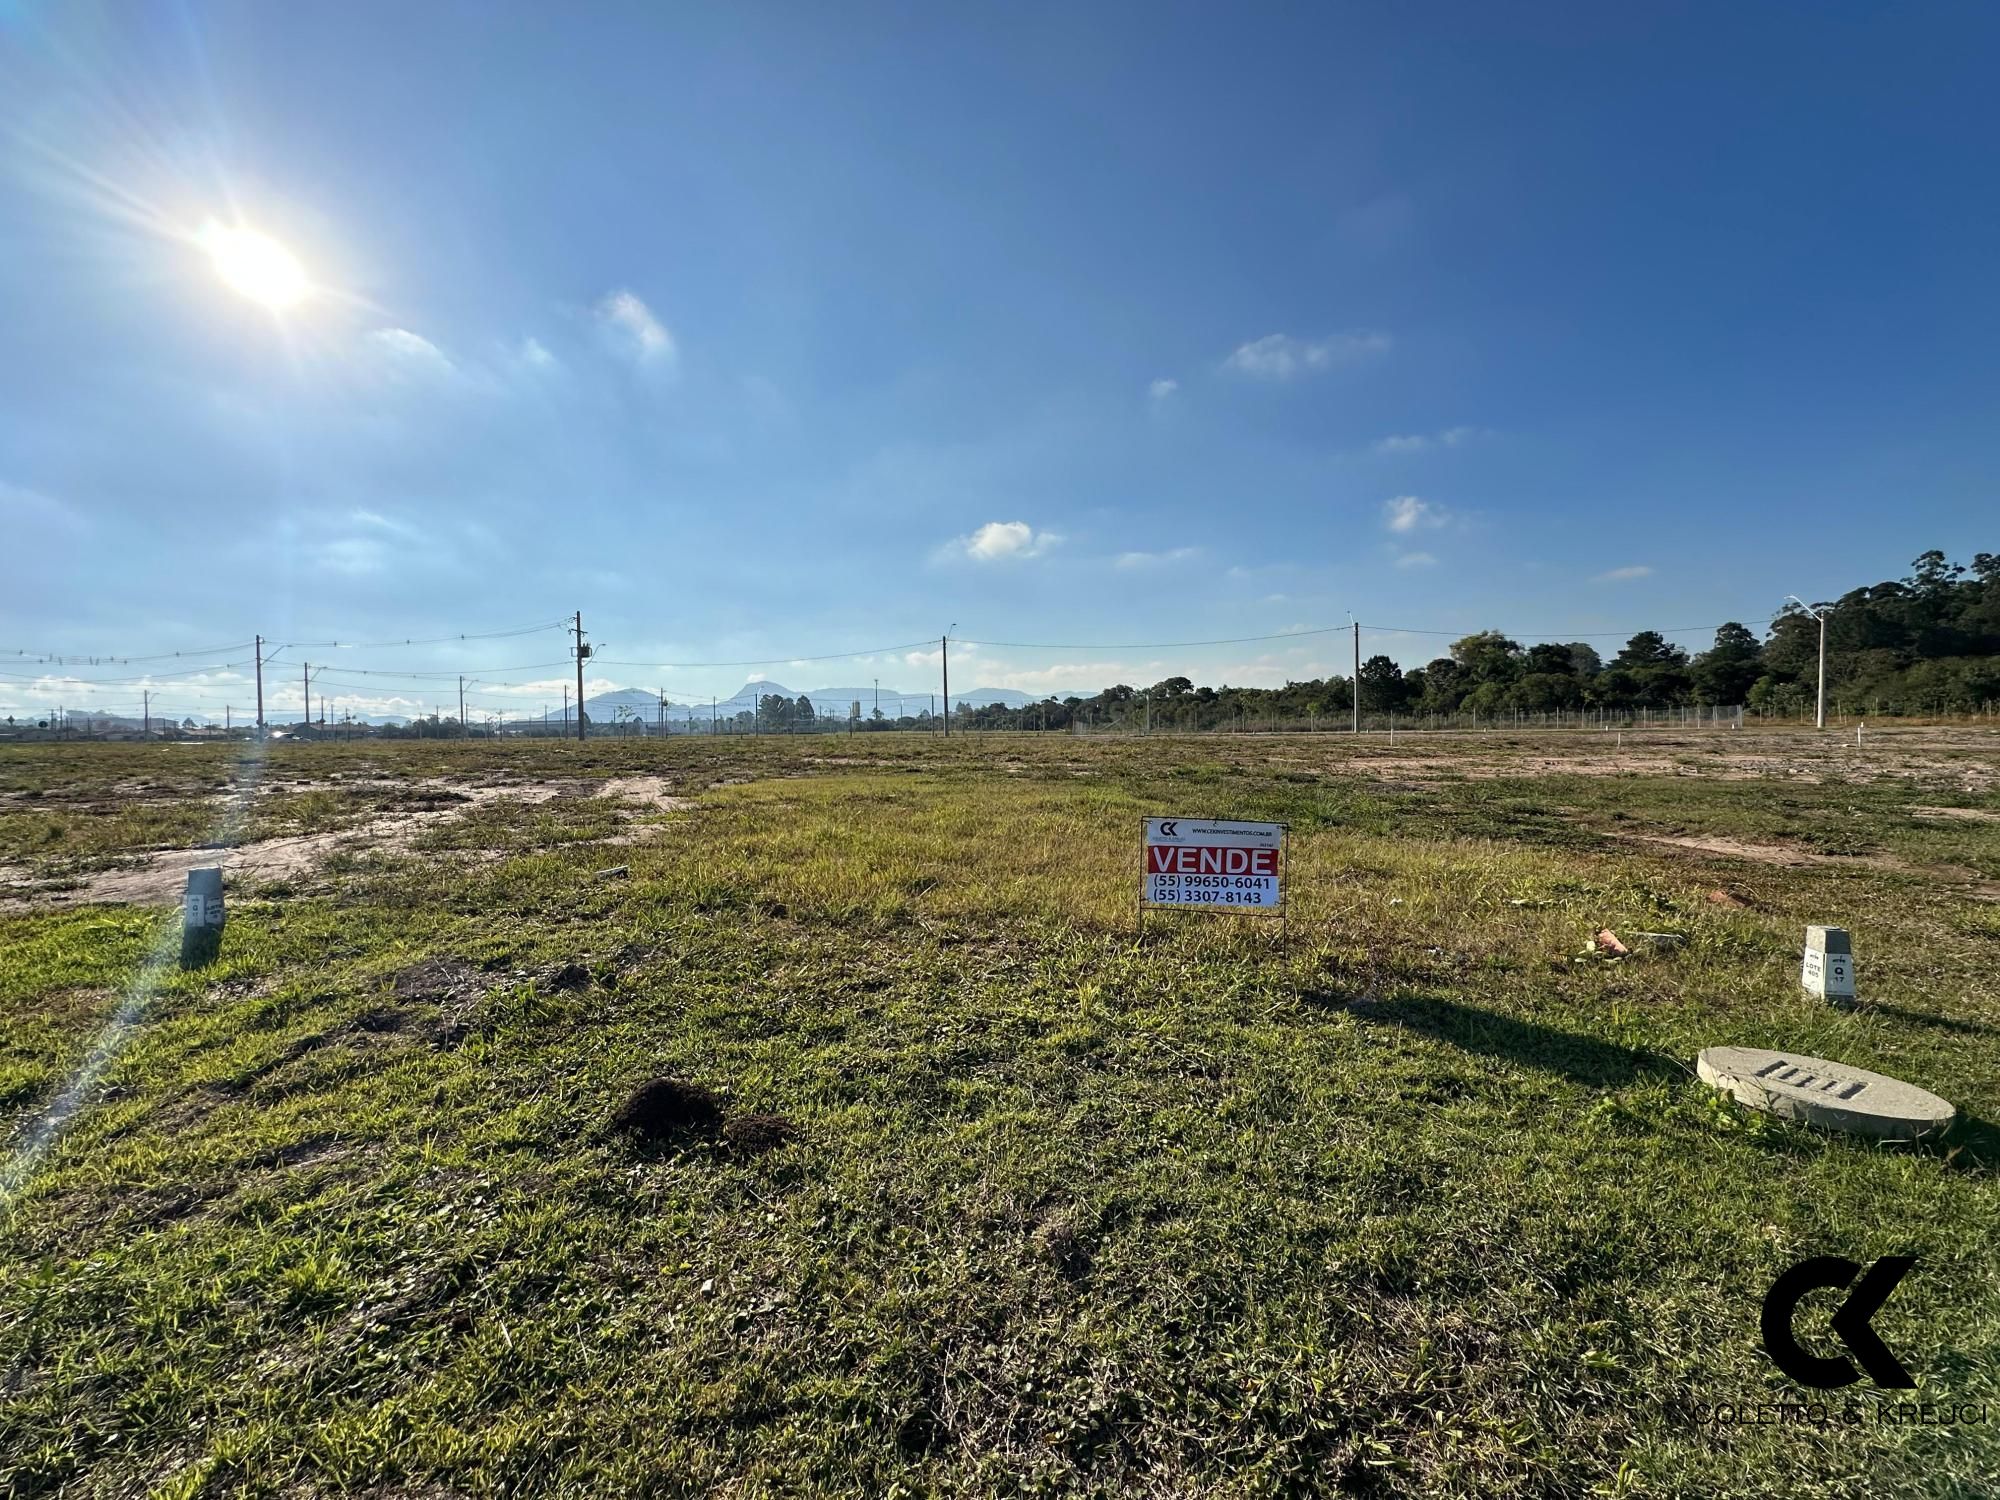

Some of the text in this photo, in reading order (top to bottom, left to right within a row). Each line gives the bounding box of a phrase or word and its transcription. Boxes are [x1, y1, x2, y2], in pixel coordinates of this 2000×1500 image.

[1153, 847, 1272, 875] VENDE
[1154, 875, 1270, 890] (55) 99650-6041
[1154, 889, 1262, 904] (55) 3307-8143
[1805, 962, 1821, 972] LOTE
[1834, 967, 1844, 976] Q
